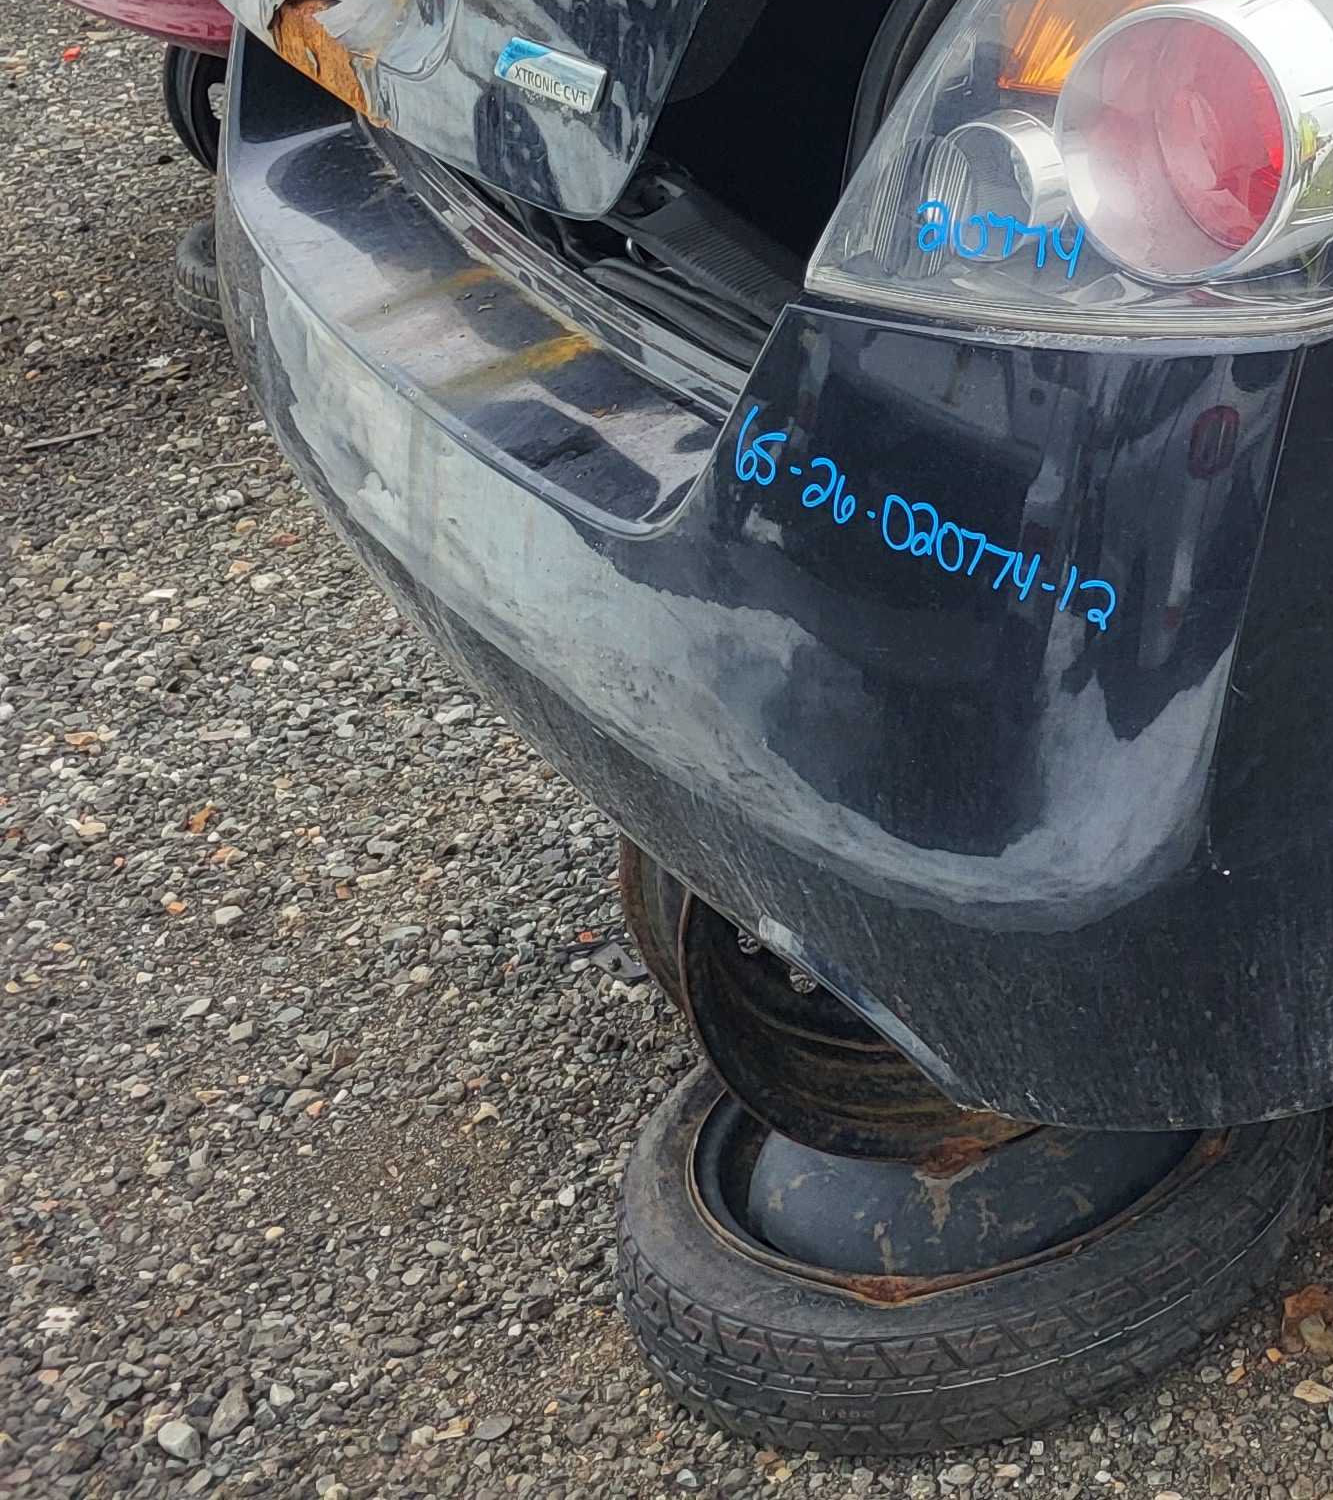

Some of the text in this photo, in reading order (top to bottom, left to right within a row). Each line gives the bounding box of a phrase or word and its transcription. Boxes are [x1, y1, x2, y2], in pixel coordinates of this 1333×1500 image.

[513, 64, 589, 107] XTRONIC CVT
[916, 199, 1086, 279] 20774
